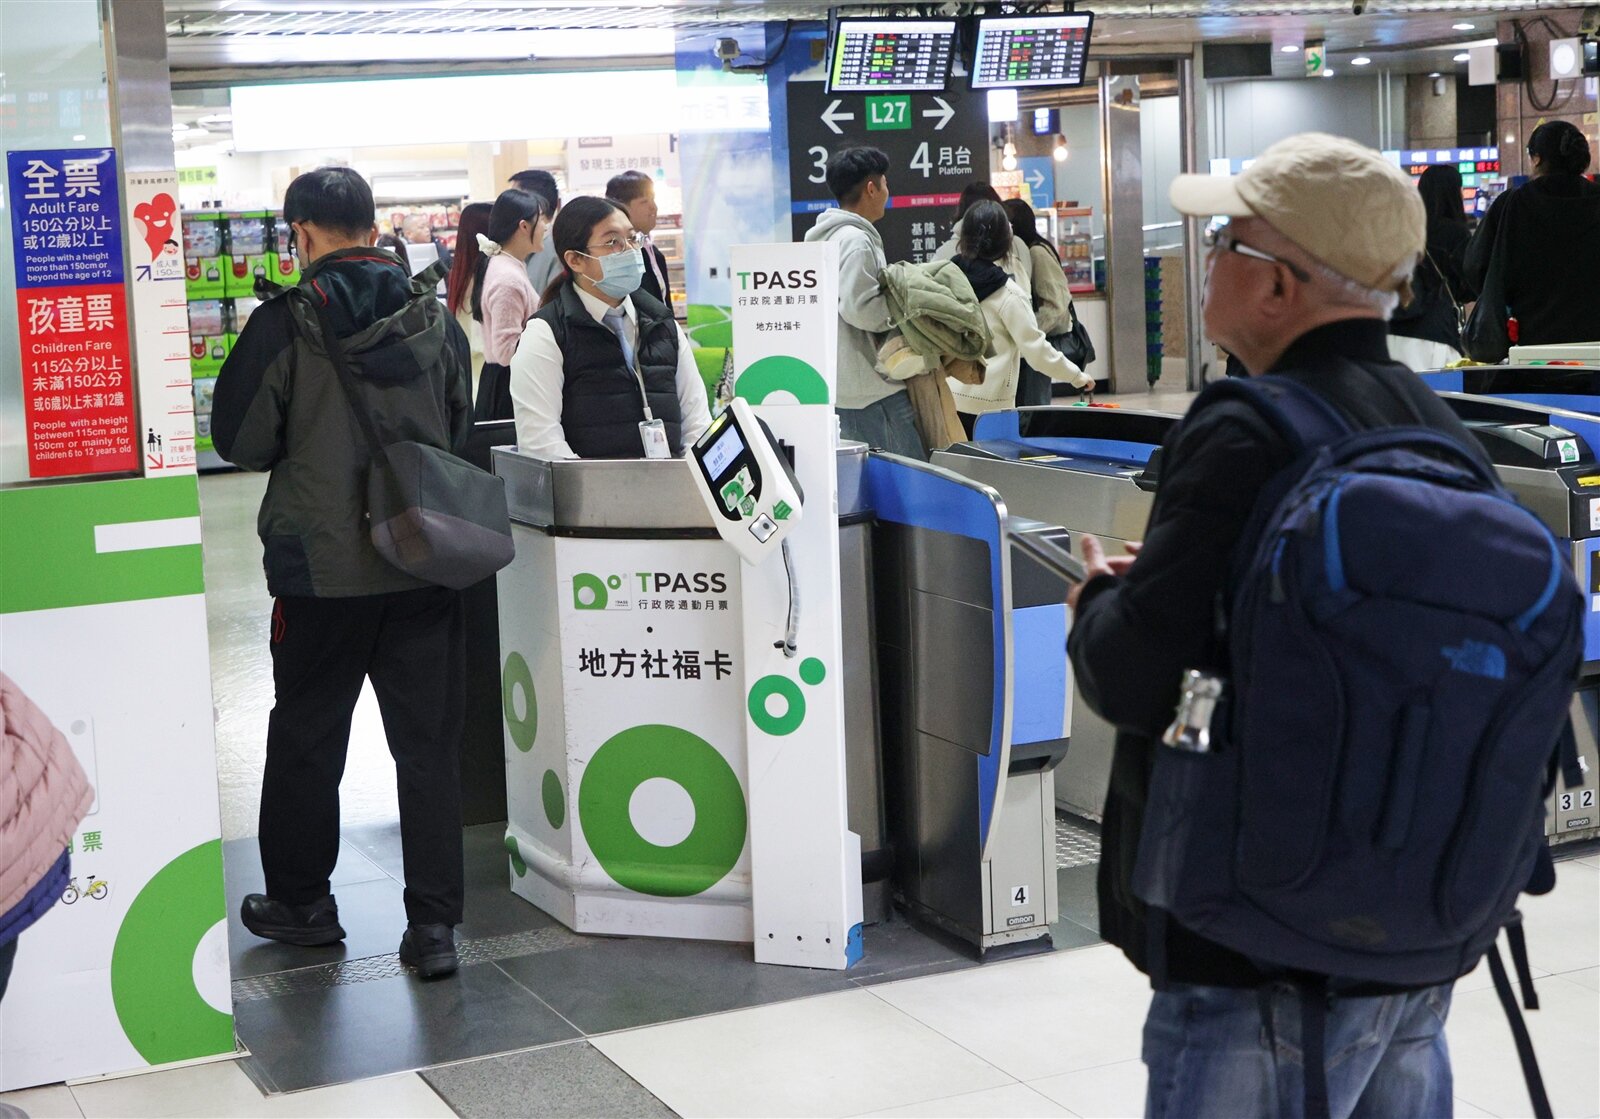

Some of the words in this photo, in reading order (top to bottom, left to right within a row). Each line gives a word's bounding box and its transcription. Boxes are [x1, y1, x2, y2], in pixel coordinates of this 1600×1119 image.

[871, 102, 907, 124] L27
[808, 145, 829, 184] 3
[909, 141, 933, 178] 4
[938, 146, 971, 166] 月台
[22, 159, 101, 199] 全票
[939, 166, 973, 176] Platform
[28, 202, 65, 215] Adult
[68, 201, 99, 213] Fare
[22, 215, 112, 232] 150公分以上
[23, 231, 104, 250] 或12歲以上
[26, 254, 56, 264] People
[56, 253, 75, 262] with
[82, 252, 109, 262] height
[26, 264, 49, 273] more
[49, 263, 69, 271] than
[70, 262, 97, 270] 150cm
[27, 273, 59, 282] beyond
[59, 271, 73, 280] the
[74, 272, 90, 281] age
[91, 270, 100, 278] of
[101, 269, 112, 278] 12
[736, 269, 818, 291] TPASS
[738, 294, 818, 307] 行政院通勤月票
[27, 294, 115, 336] 孩童票
[756, 321, 801, 332] 地方社福卡
[32, 342, 83, 355] Children
[85, 340, 113, 351] Fare
[32, 354, 123, 374] 115公分以上
[32, 371, 123, 392] 未滿150公分
[33, 391, 125, 412] 或6歲以上未滿12歲
[33, 420, 66, 431] People
[70, 418, 90, 428] with
[98, 416, 129, 426] height
[34, 431, 74, 440] between
[76, 428, 107, 437] 115cm
[110, 426, 128, 435] and
[33, 441, 64, 451] 150cm
[68, 440, 79, 448] or
[81, 437, 113, 447] mainly
[116, 437, 130, 445] for
[36, 451, 67, 461] children
[68, 449, 74, 458] 6
[75, 449, 83, 457] to
[84, 447, 94, 456] 12
[95, 446, 117, 457] years
[119, 445, 132, 454] old
[635, 572, 727, 594] TPASS
[638, 599, 729, 611] 行政院通勤月票
[578, 647, 733, 681] 地方社福卡
[1562, 794, 1571, 810] 3
[1583, 790, 1592, 807] 2
[1014, 886, 1026, 904] 4
